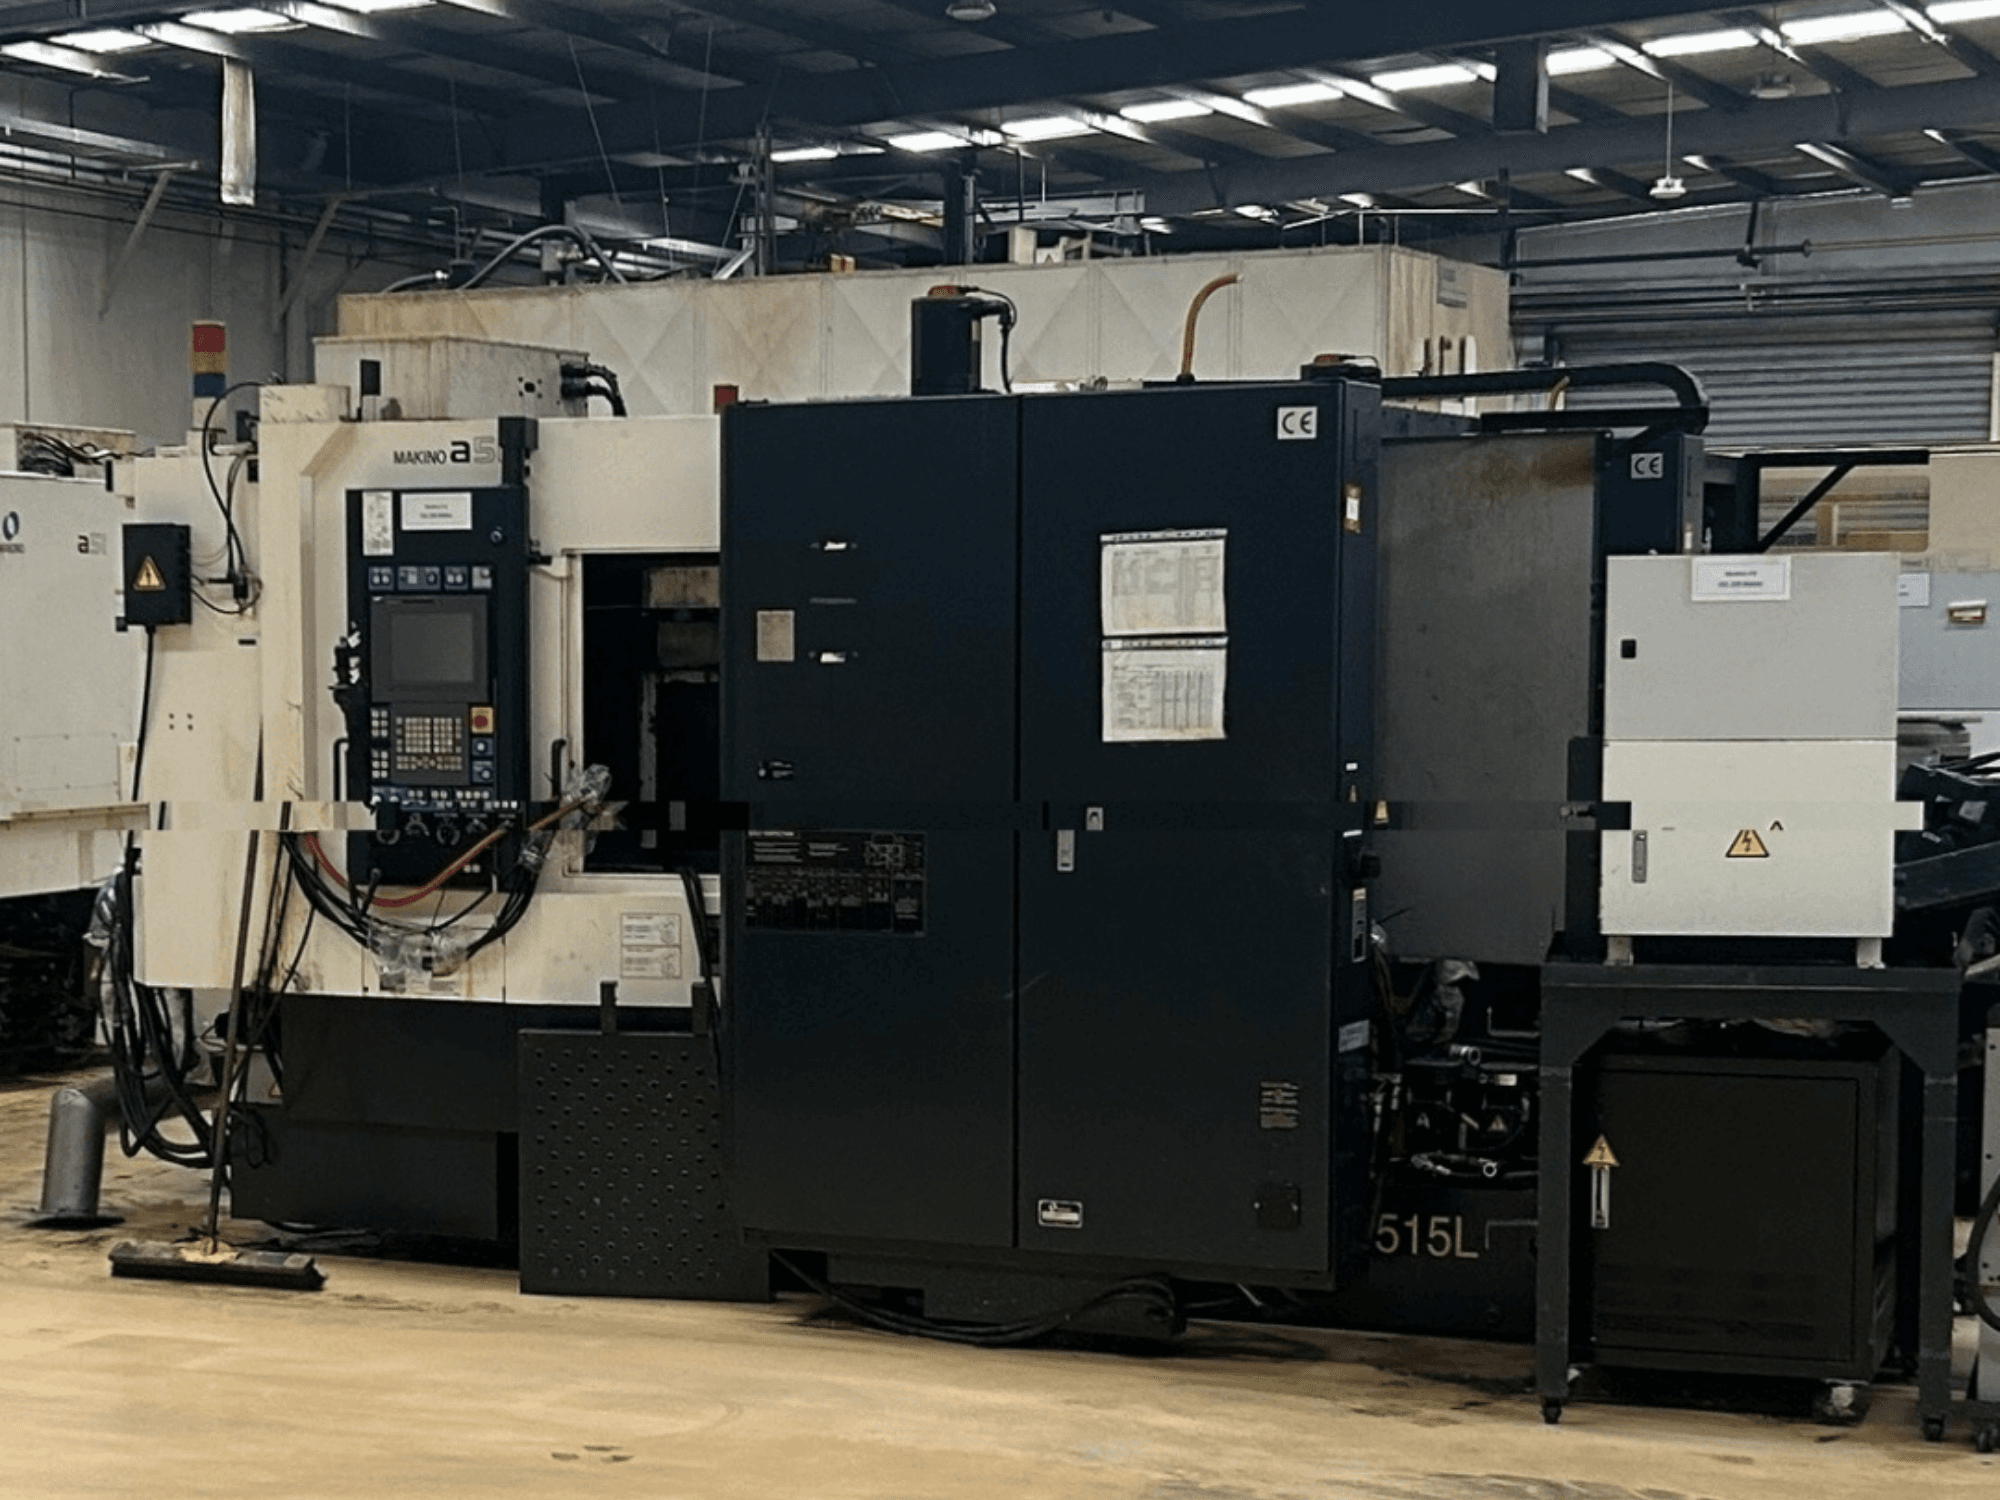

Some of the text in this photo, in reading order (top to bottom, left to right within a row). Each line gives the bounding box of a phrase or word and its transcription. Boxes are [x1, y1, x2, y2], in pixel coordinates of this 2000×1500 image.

[1282, 411, 1313, 435] CE
[393, 450, 447, 465] MAKINO
[1634, 457, 1660, 475] CE
[1375, 1213, 1479, 1258] 515L
